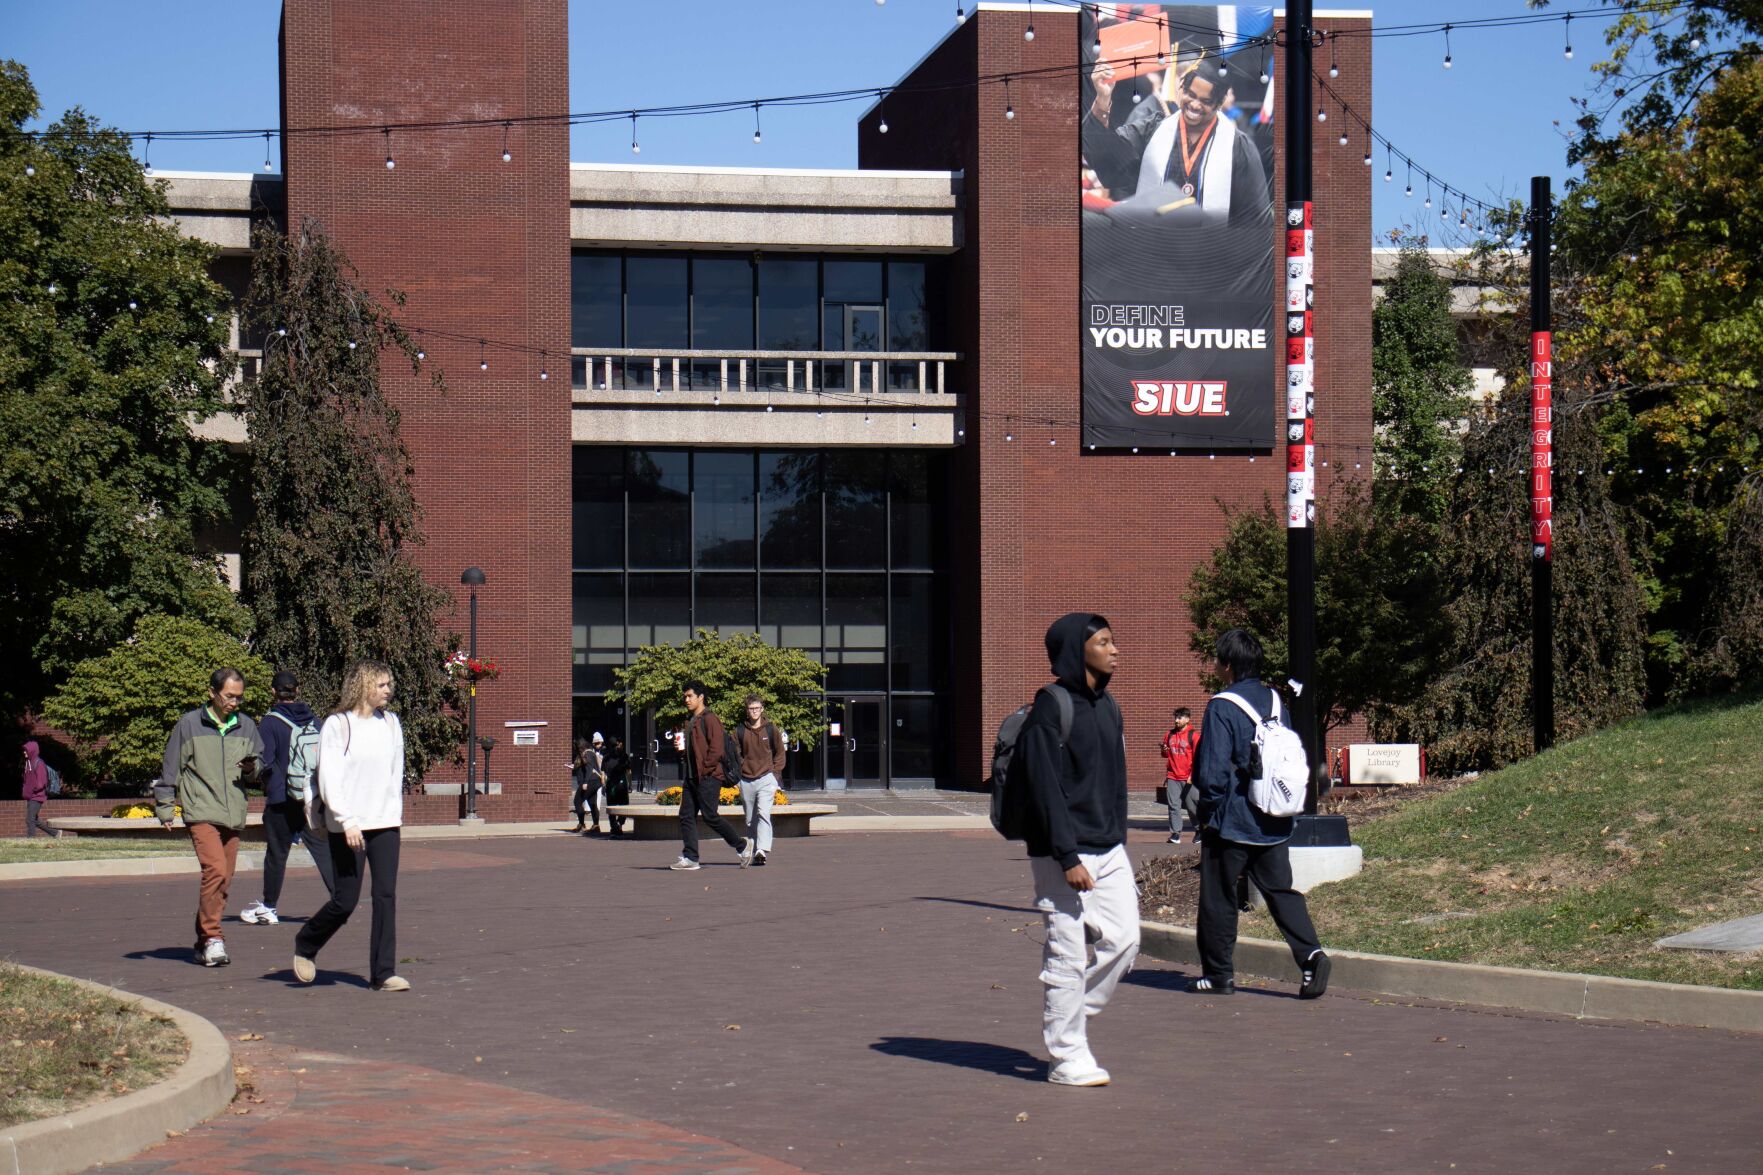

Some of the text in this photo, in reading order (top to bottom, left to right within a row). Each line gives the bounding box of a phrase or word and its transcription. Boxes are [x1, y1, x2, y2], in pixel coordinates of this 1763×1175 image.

[1091, 304, 1185, 326] DEFINE
[1089, 327, 1267, 349] YOUR FUTURE
[1131, 381, 1227, 416] SIUE
[1531, 339, 1548, 536] INTEGRITY
[1367, 748, 1401, 758] Lovejoy
[1368, 758, 1401, 767] Library
